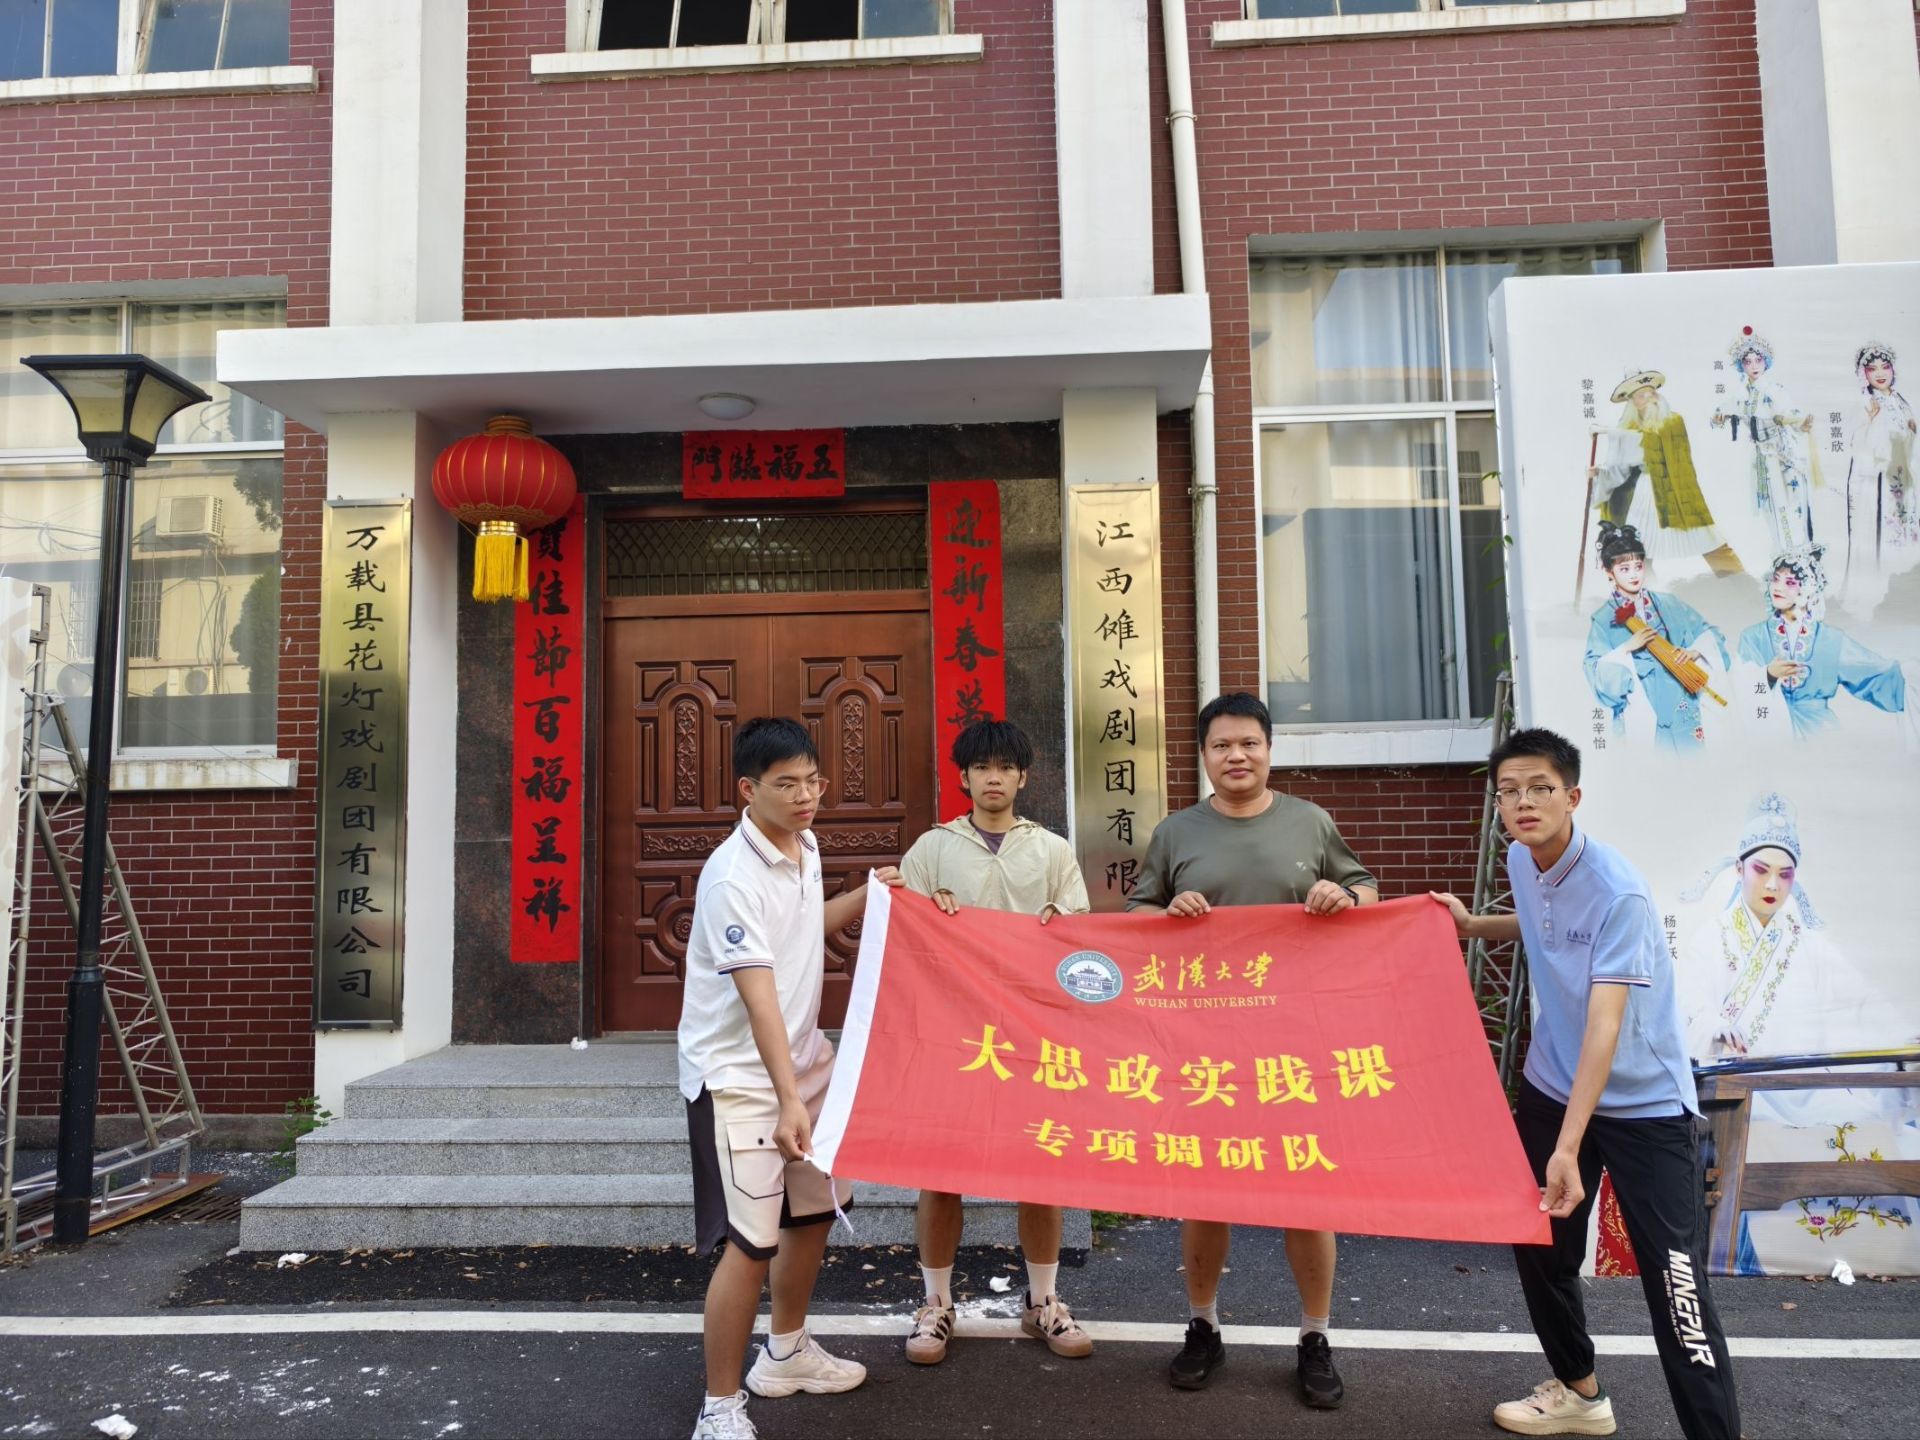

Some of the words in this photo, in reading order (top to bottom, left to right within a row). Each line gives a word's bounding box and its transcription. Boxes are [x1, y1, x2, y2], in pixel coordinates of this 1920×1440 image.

[1829, 412, 1844, 452] 郭嘉欣
[1094, 519, 1140, 896] 江西傩戏剧团有限
[1754, 682, 1769, 719] 龙好
[1591, 707, 1606, 750] 龙辛怡
[333, 525, 387, 999] 万载县花灯戏剧团有限公司
[1134, 997, 1188, 1009] WUHAN
[1192, 994, 1278, 1009] UNIVERSITY
[958, 1024, 1396, 1107] 大思政实践课
[1023, 1118, 1339, 1172] 专项调研队
